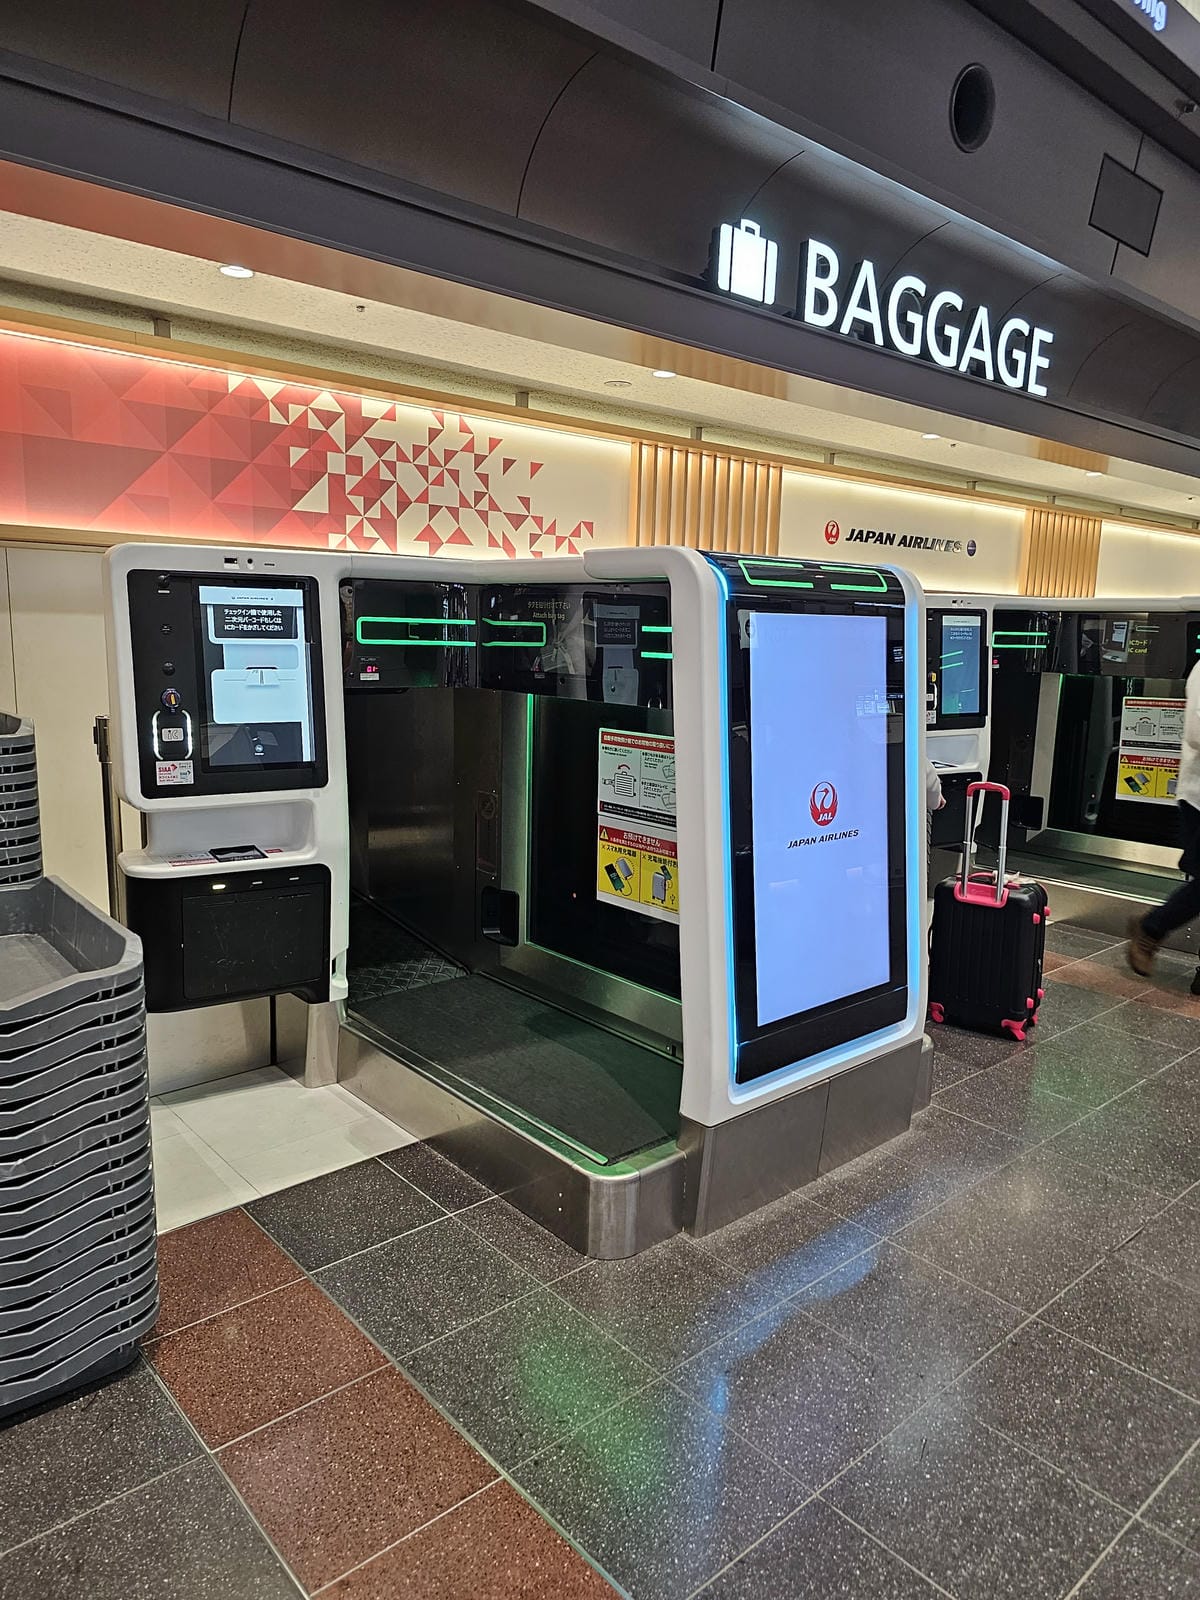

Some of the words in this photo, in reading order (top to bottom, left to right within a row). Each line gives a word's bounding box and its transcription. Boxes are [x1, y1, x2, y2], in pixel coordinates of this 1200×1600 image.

[804, 237, 1055, 397] BAGGAGE
[845, 528, 896, 546] JAPAN
[897, 534, 963, 553] AIRLINES
[817, 812, 833, 822] JAL
[623, 831, 660, 847] お預けできません
[787, 836, 817, 849] JAPAN
[818, 829, 859, 843] AIRLINES
